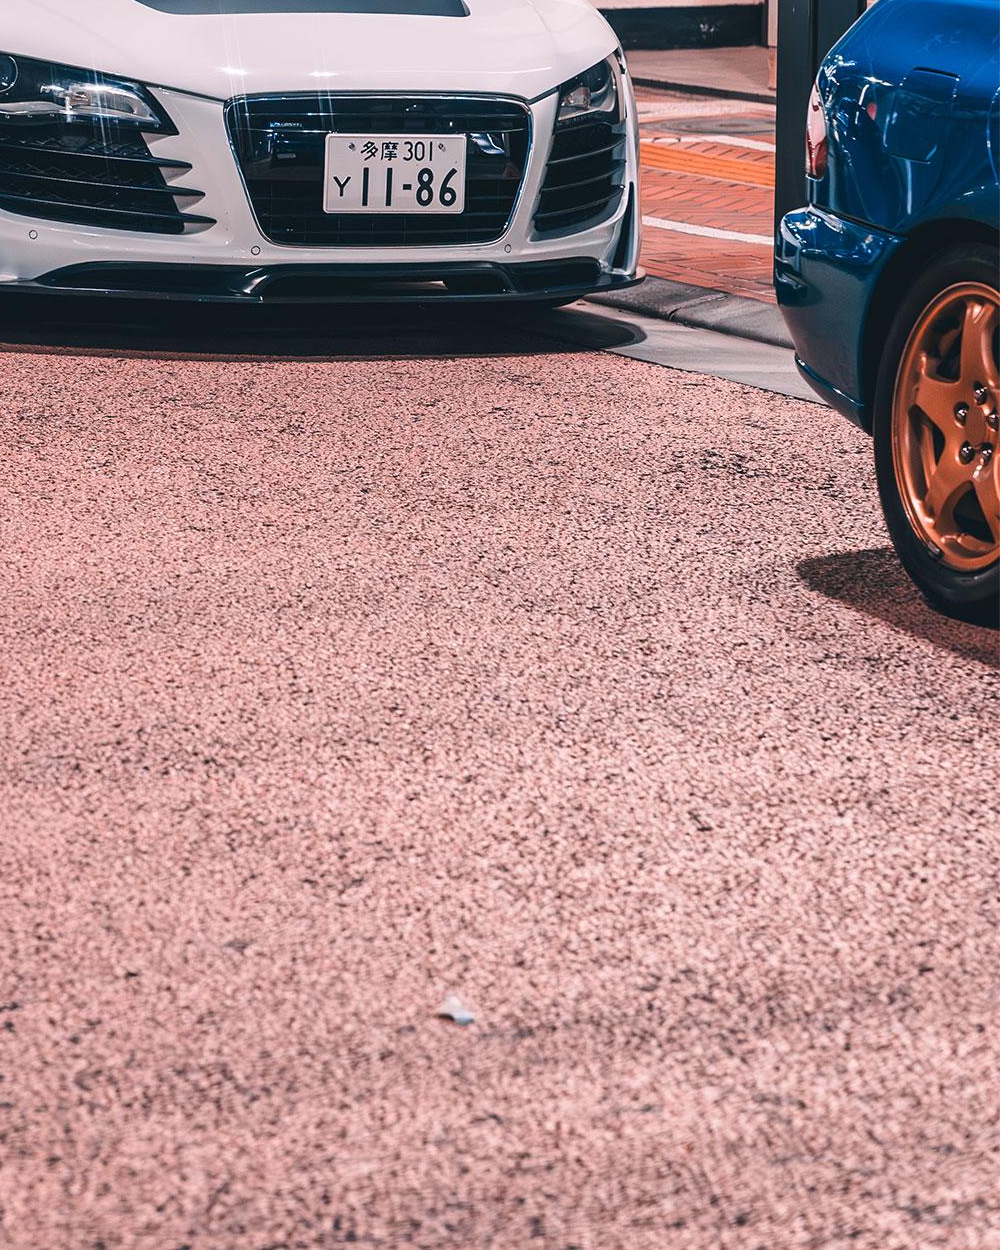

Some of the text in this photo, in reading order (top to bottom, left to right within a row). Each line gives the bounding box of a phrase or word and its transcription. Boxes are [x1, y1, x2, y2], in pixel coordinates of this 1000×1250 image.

[360, 141, 433, 161] 多摩 301
[333, 167, 458, 207] Y 11-86
